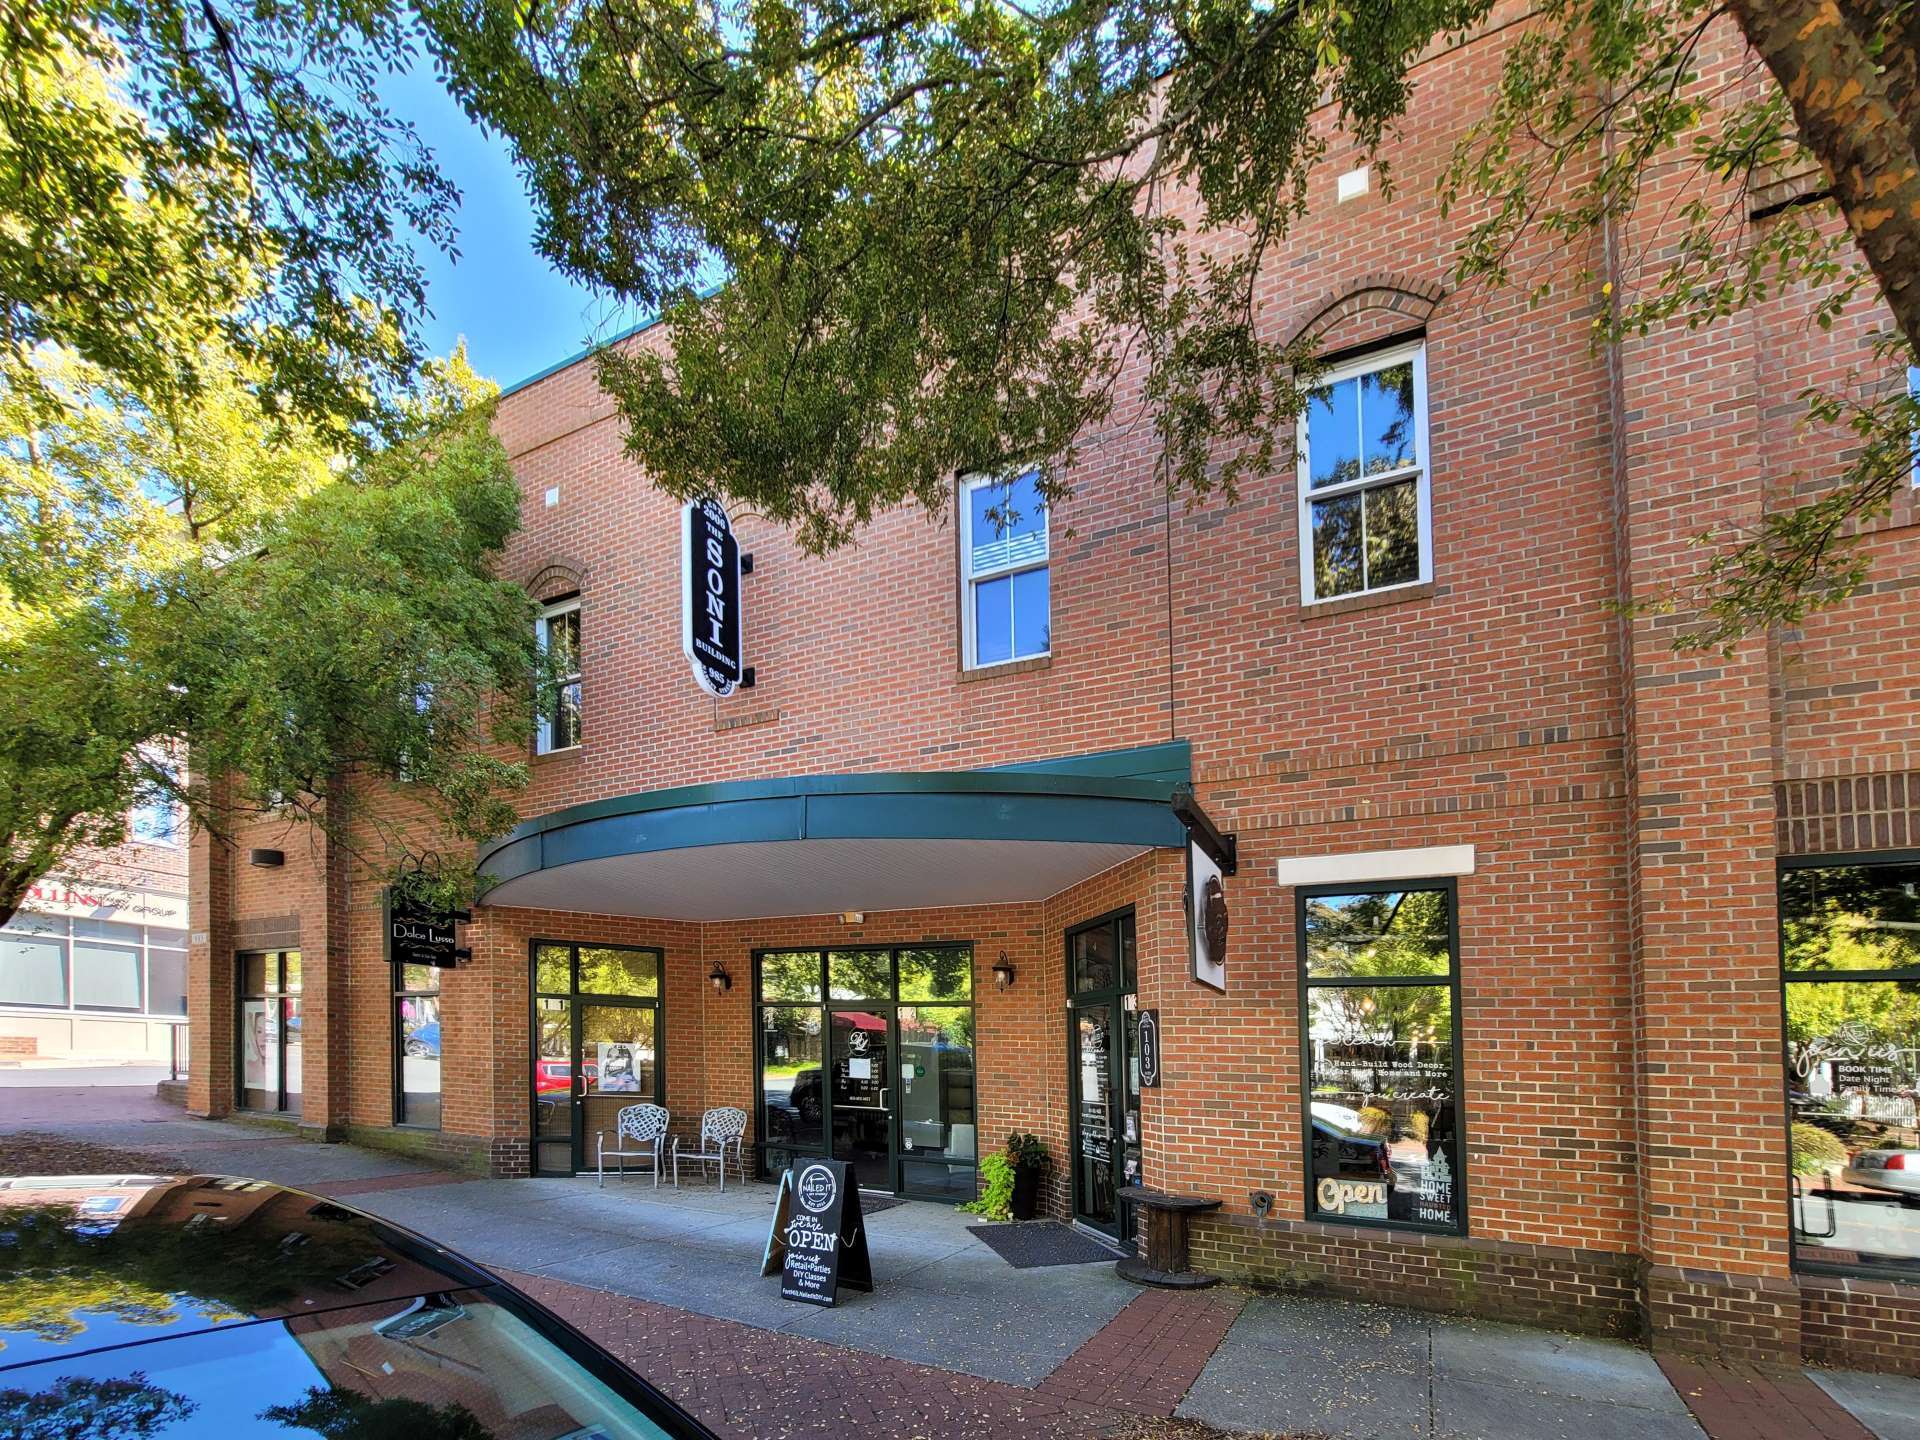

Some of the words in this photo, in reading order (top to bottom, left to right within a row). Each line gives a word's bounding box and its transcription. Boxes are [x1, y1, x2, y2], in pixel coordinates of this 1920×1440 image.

[705, 520, 724, 541] THE
[706, 537, 725, 648] SONI
[695, 637, 737, 670] BUILDING
[708, 667, 725, 684] 985
[25, 884, 100, 907] OLLINS
[393, 923, 426, 939] Dolce
[429, 928, 455, 943] Lusso
[544, 999, 564, 1010] 11
[1143, 1030, 1151, 1069] 103
[1868, 1042, 1898, 1061] us
[1334, 1060, 1389, 1068] Hand-Build
[1392, 1061, 1413, 1069] Wood
[1416, 1061, 1445, 1069] Decor
[1838, 1065, 1866, 1073] BOOK
[1868, 1066, 1893, 1074] TIME
[1378, 1069, 1401, 1077] Home
[1425, 1070, 1448, 1078] More
[1839, 1074, 1861, 1082] Date
[1863, 1075, 1890, 1084] Night
[1362, 1091, 1391, 1108] you
[1392, 1085, 1450, 1101] create
[1839, 1084, 1871, 1093] Family
[1872, 1085, 1897, 1093] Time
[803, 1182, 825, 1192] NAILED
[825, 1183, 833, 1192] IT
[1420, 1180, 1452, 1195] HOME
[1317, 1177, 1388, 1215] Open
[1419, 1192, 1451, 1204] SWEET
[796, 1214, 811, 1222] COME
[1419, 1207, 1451, 1223] HOME
[789, 1229, 836, 1252] OPEN
[785, 1249, 809, 1269] join
[808, 1254, 821, 1264] us
[793, 1269, 804, 1278] DIY
[804, 1271, 827, 1282] Classes
[804, 1280, 820, 1289] More
